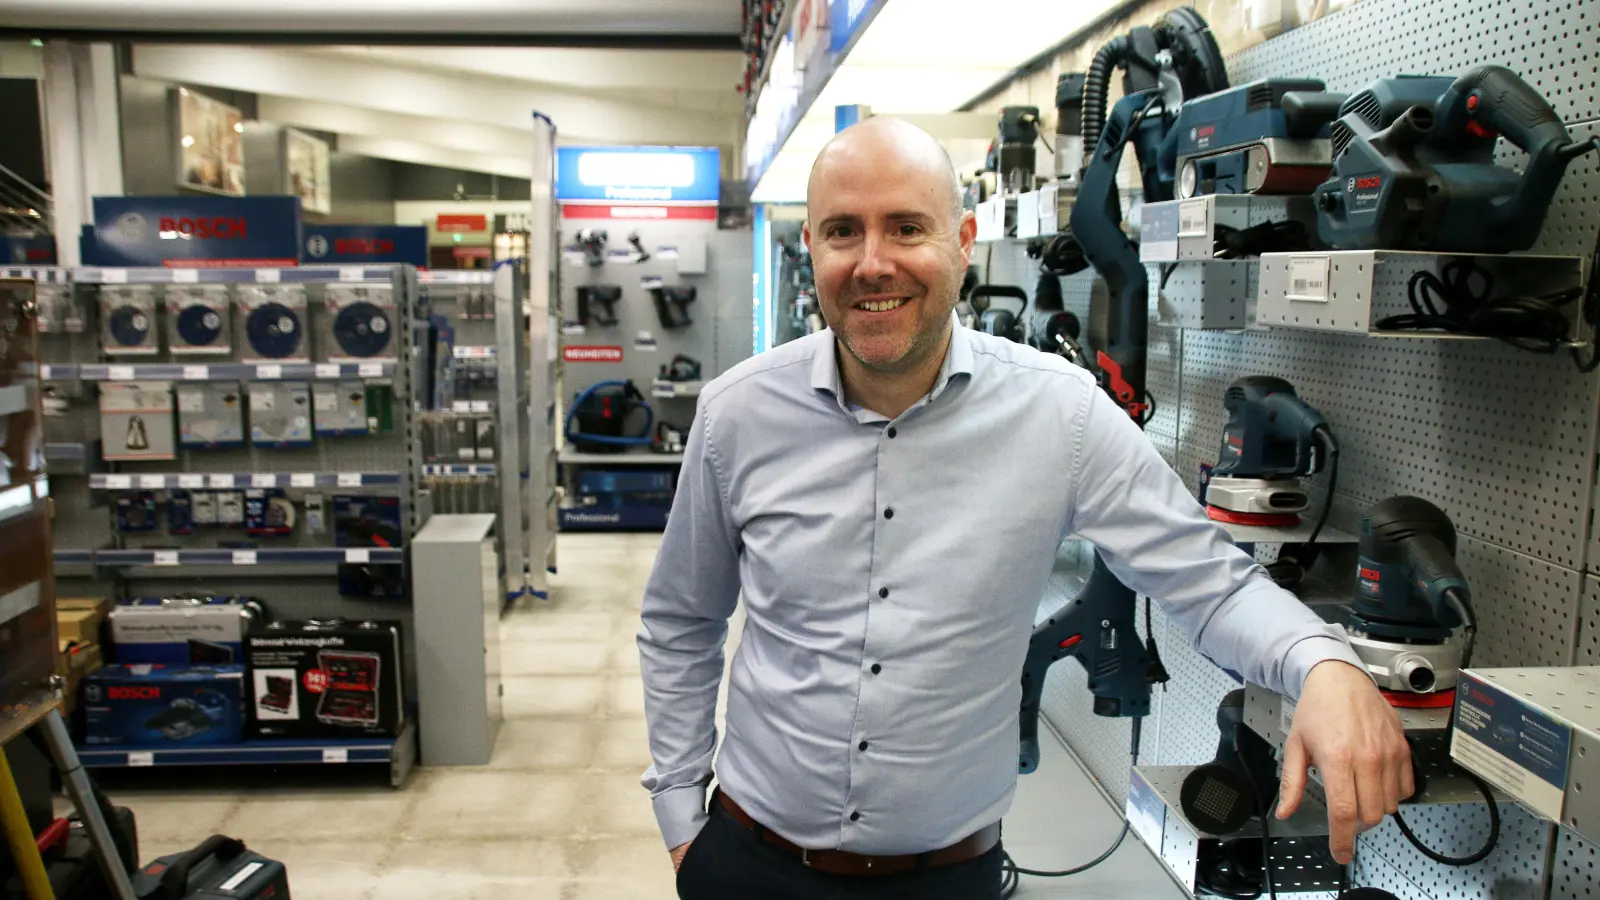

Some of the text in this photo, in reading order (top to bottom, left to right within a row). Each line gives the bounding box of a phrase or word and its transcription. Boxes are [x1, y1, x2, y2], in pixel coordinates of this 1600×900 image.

[1357, 176, 1381, 189] BOSCH
[159, 217, 247, 239] BOSCH
[334, 238, 394, 255] BOSCH
[565, 512, 620, 523] Professional
[108, 686, 160, 700] BOSCH
[1471, 689, 1495, 708] BOSCH
